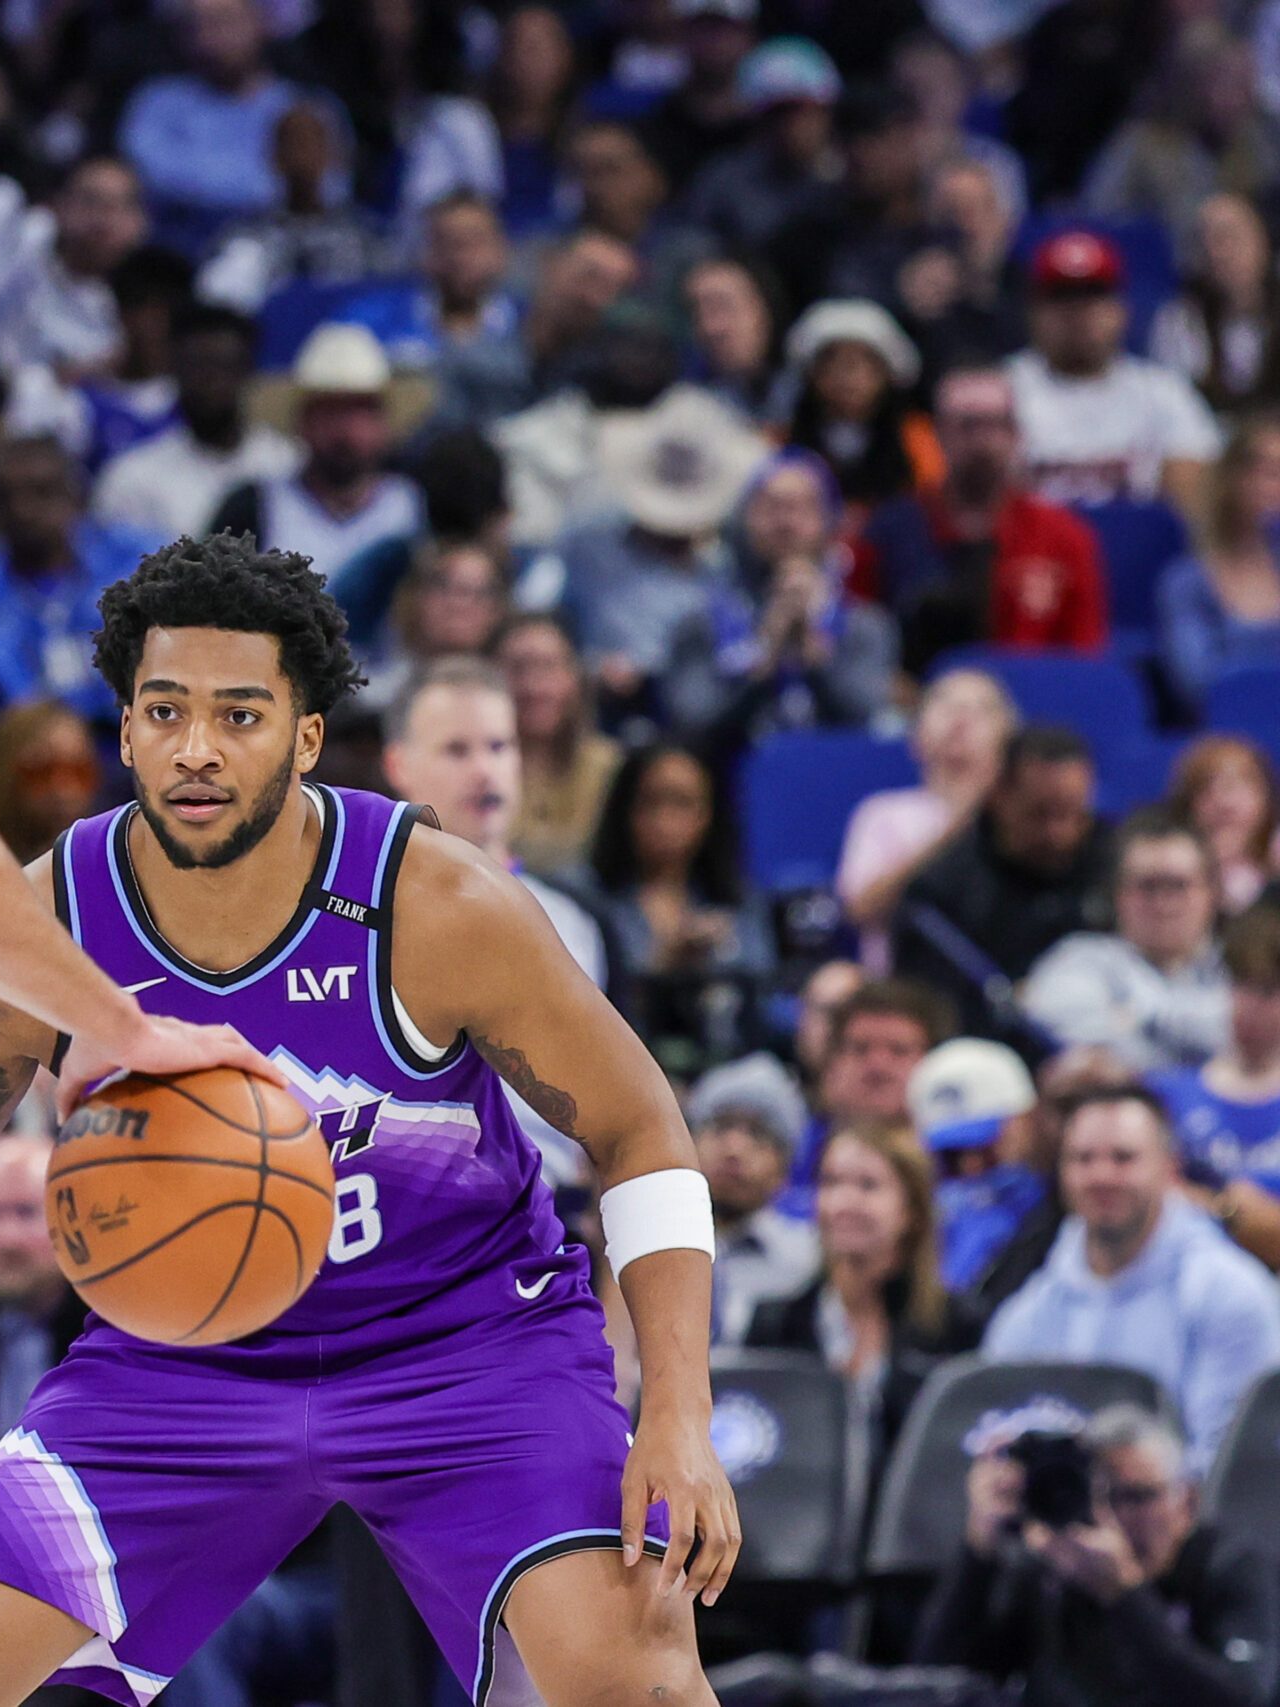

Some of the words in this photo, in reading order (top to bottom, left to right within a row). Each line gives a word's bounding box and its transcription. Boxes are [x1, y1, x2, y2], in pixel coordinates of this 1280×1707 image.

[326, 896, 368, 922] FRANK
[287, 966, 358, 1002] LVT
[328, 1173, 382, 1264] 8
